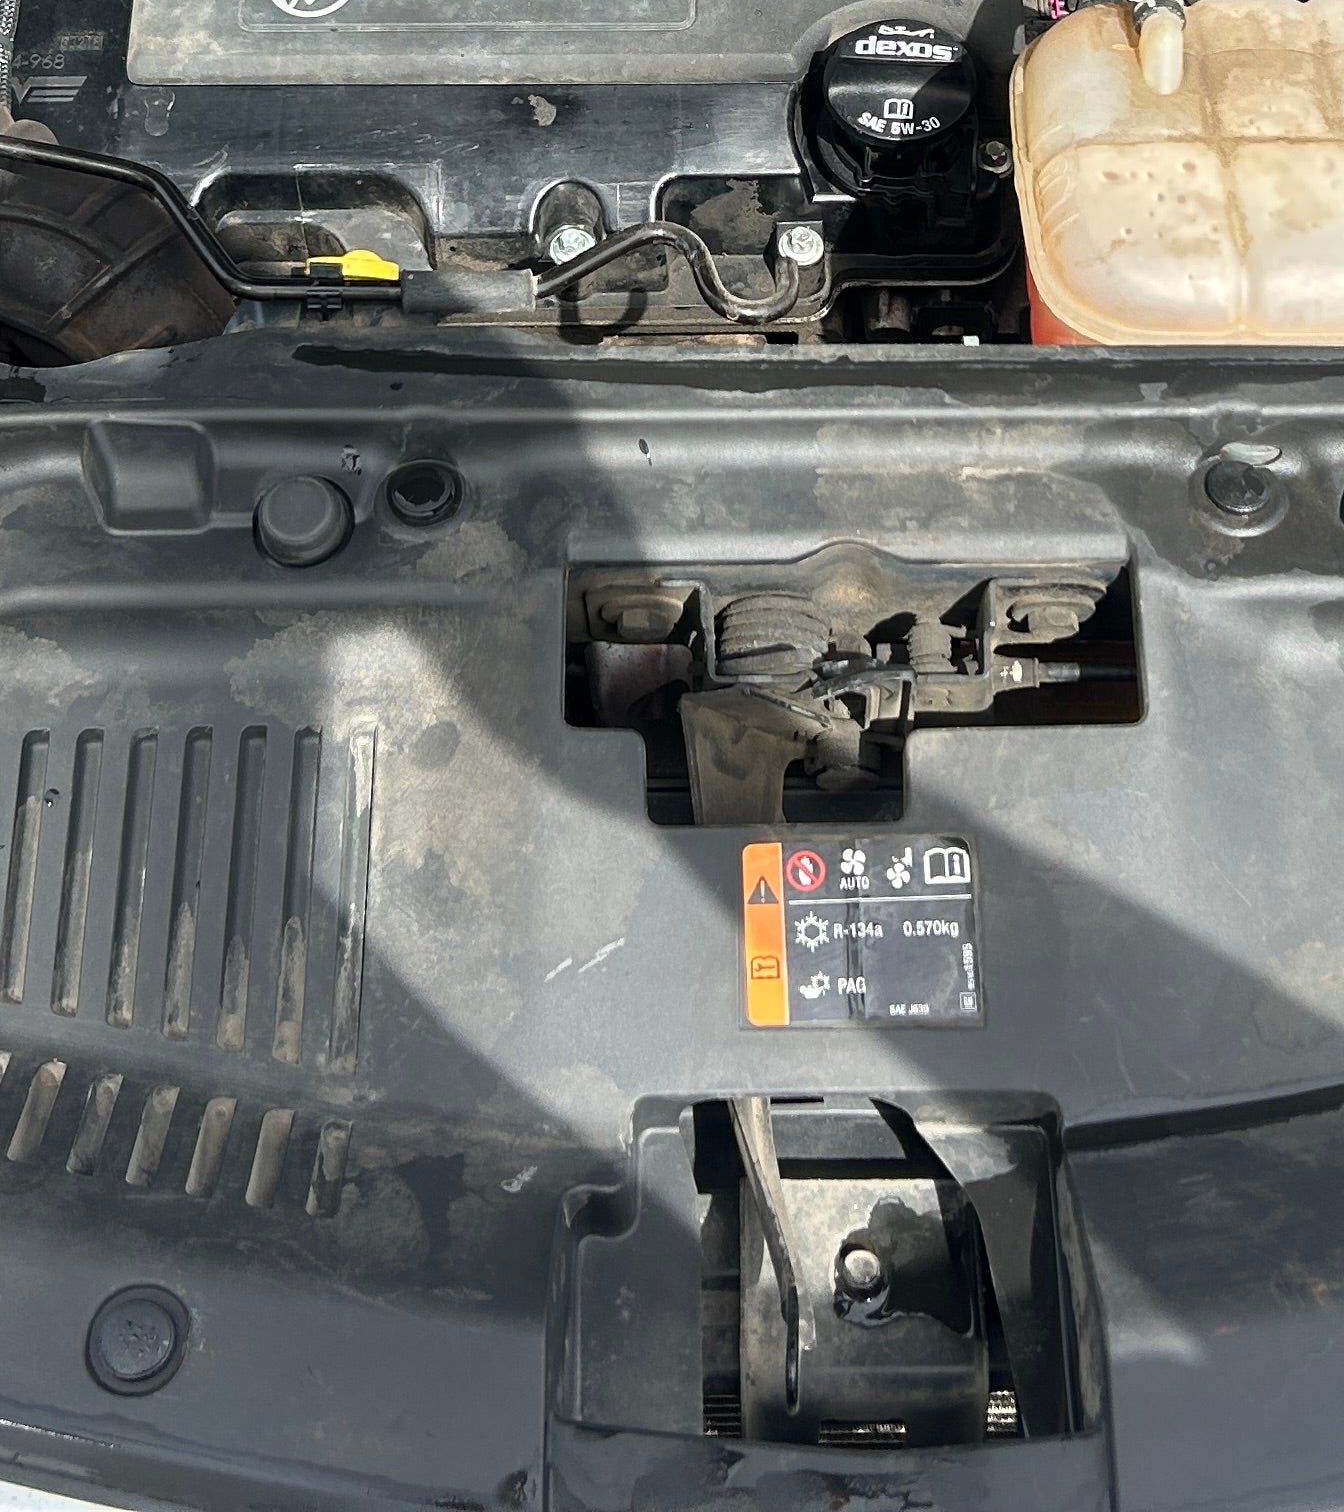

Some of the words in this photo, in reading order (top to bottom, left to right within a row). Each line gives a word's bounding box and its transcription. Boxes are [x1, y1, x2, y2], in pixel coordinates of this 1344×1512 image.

[854, 35, 953, 61] dexos
[857, 112, 888, 133] SAE
[890, 116, 941, 135] 5W-30
[839, 876, 870, 890] AUTO
[832, 921, 884, 940] R-134a
[902, 920, 960, 938] 0.570kg
[837, 977, 867, 995] PAG
